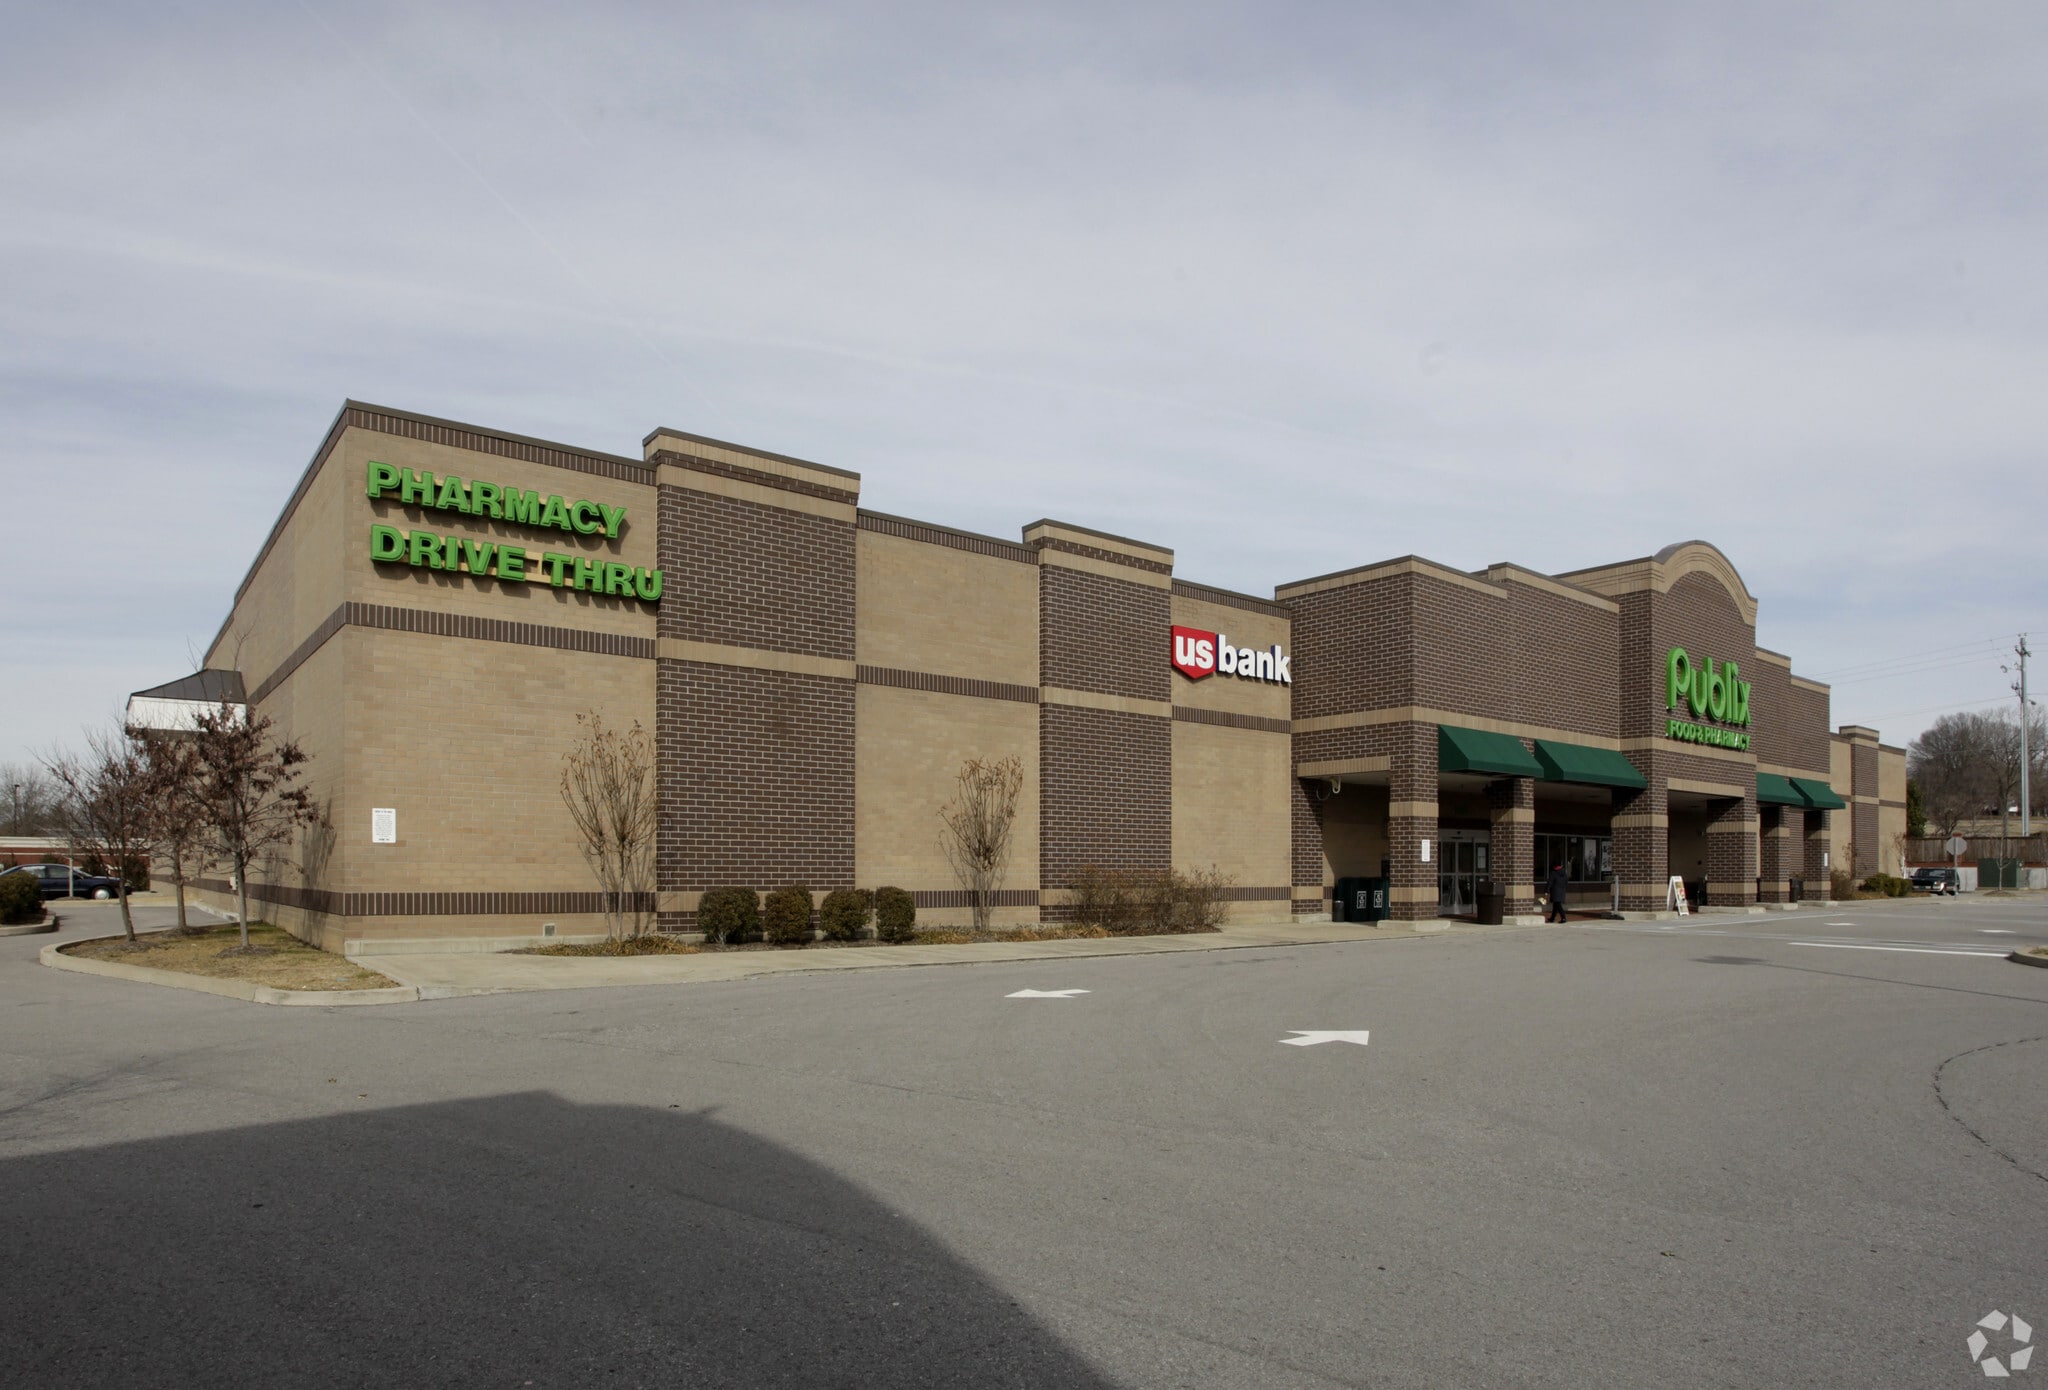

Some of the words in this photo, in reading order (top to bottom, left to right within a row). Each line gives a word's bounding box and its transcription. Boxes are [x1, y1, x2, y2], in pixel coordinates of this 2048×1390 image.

[367, 460, 627, 540] PHARMACY
[370, 524, 527, 583] DRIVE
[542, 552, 664, 601] THRU
[1666, 647, 1752, 726] Publix
[1667, 719, 1697, 741] FOOD
[1704, 727, 1751, 750] PHARMACY
